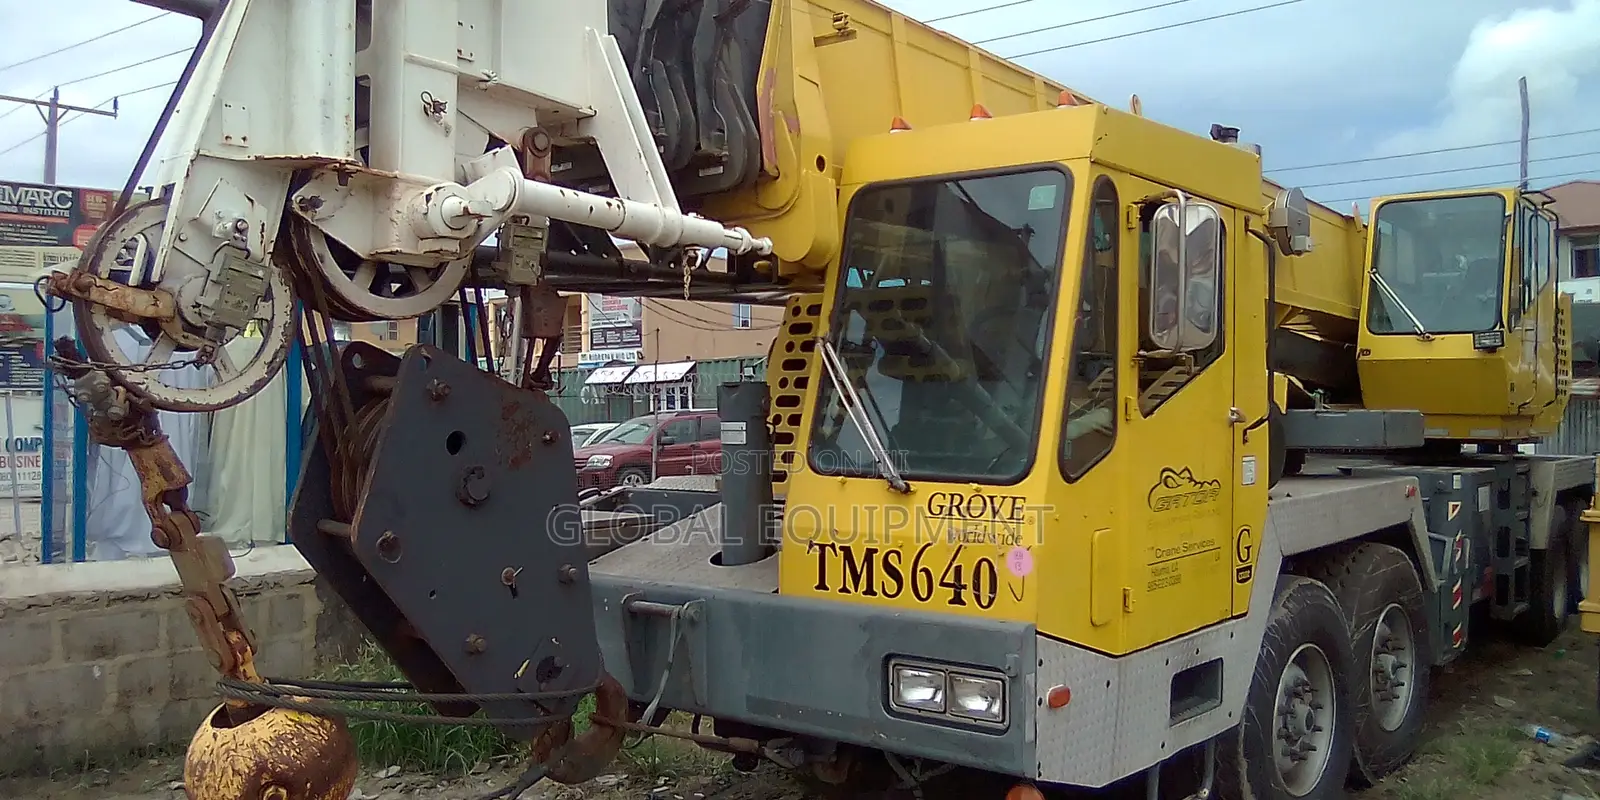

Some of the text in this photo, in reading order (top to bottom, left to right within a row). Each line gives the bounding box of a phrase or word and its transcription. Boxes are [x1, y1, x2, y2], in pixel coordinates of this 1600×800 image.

[23, 206, 70, 217] INSTITUTE
[927, 492, 1026, 520] GROVE
[1153, 488, 1221, 513] GATOR
[1155, 544, 1181, 559] Crane
[1182, 538, 1216, 553] Services
[1236, 527, 1252, 563] G
[806, 540, 998, 610] TMS640
